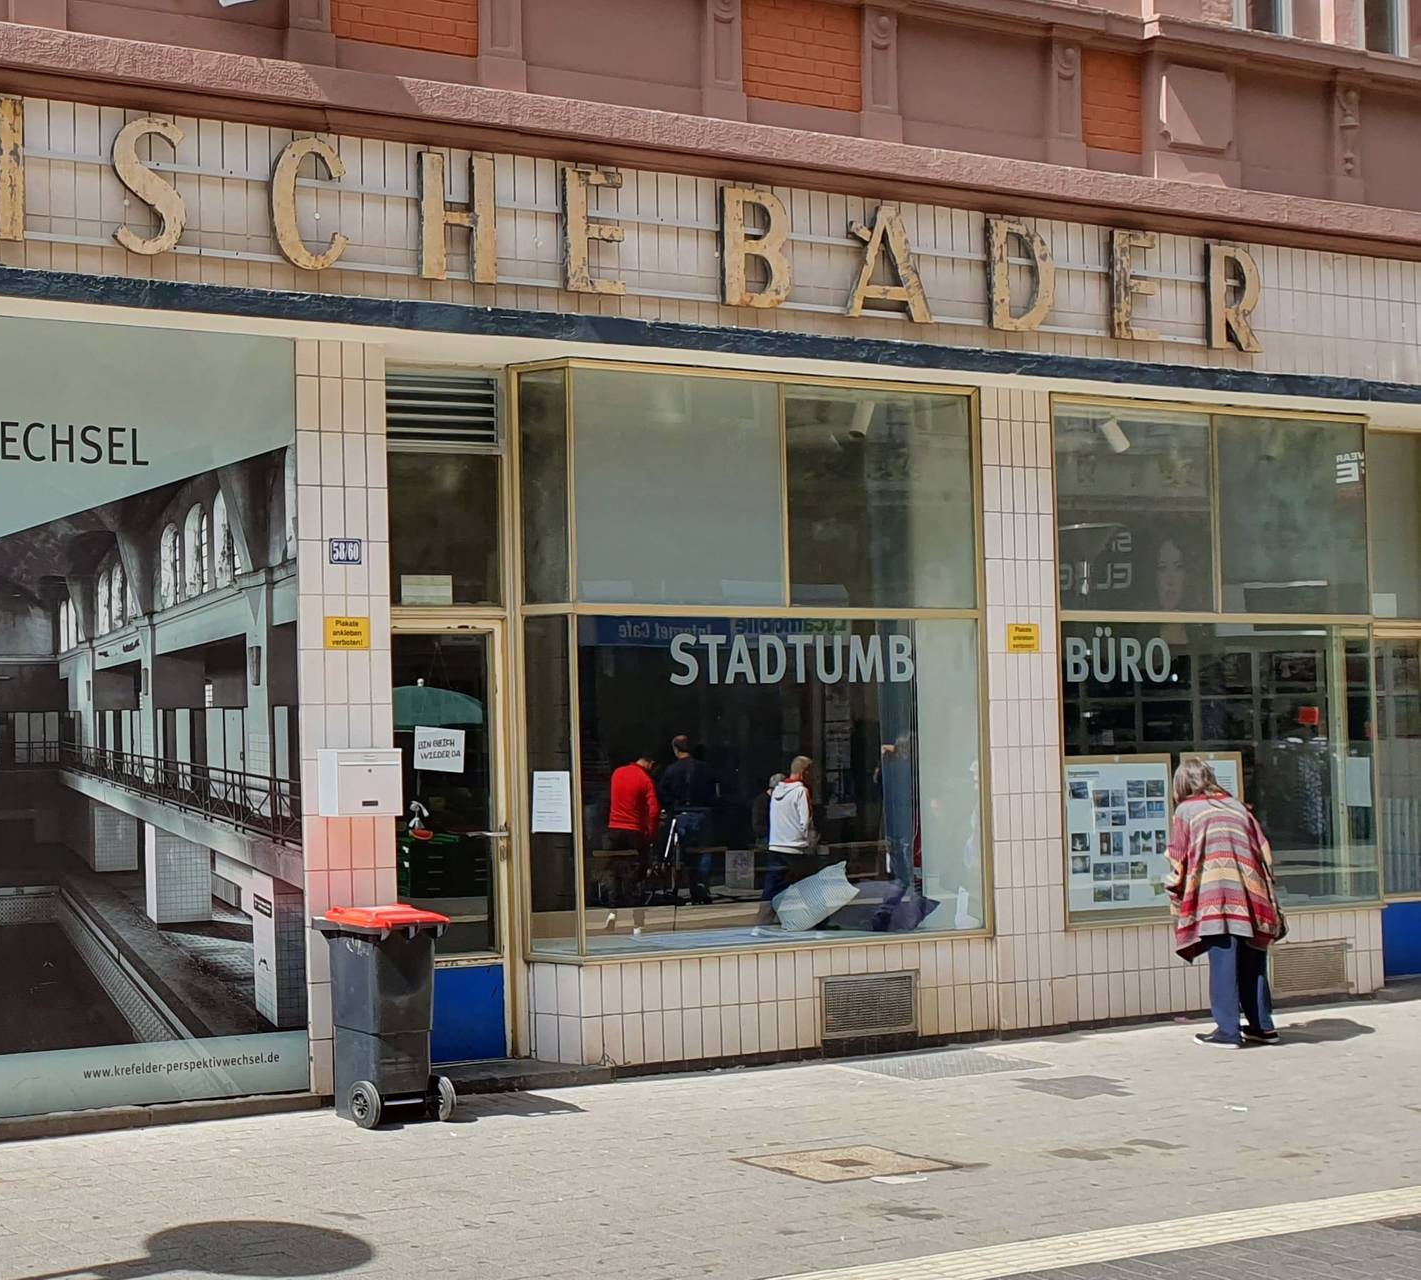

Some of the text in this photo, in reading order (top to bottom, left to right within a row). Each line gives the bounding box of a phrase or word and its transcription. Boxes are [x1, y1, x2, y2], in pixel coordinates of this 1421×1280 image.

[332, 542, 359, 561] 58/60
[669, 626, 1179, 686] STADTUMB BÜRO.
[83, 1052, 281, 1079] www.krefelder-perspektivwechsel.de
